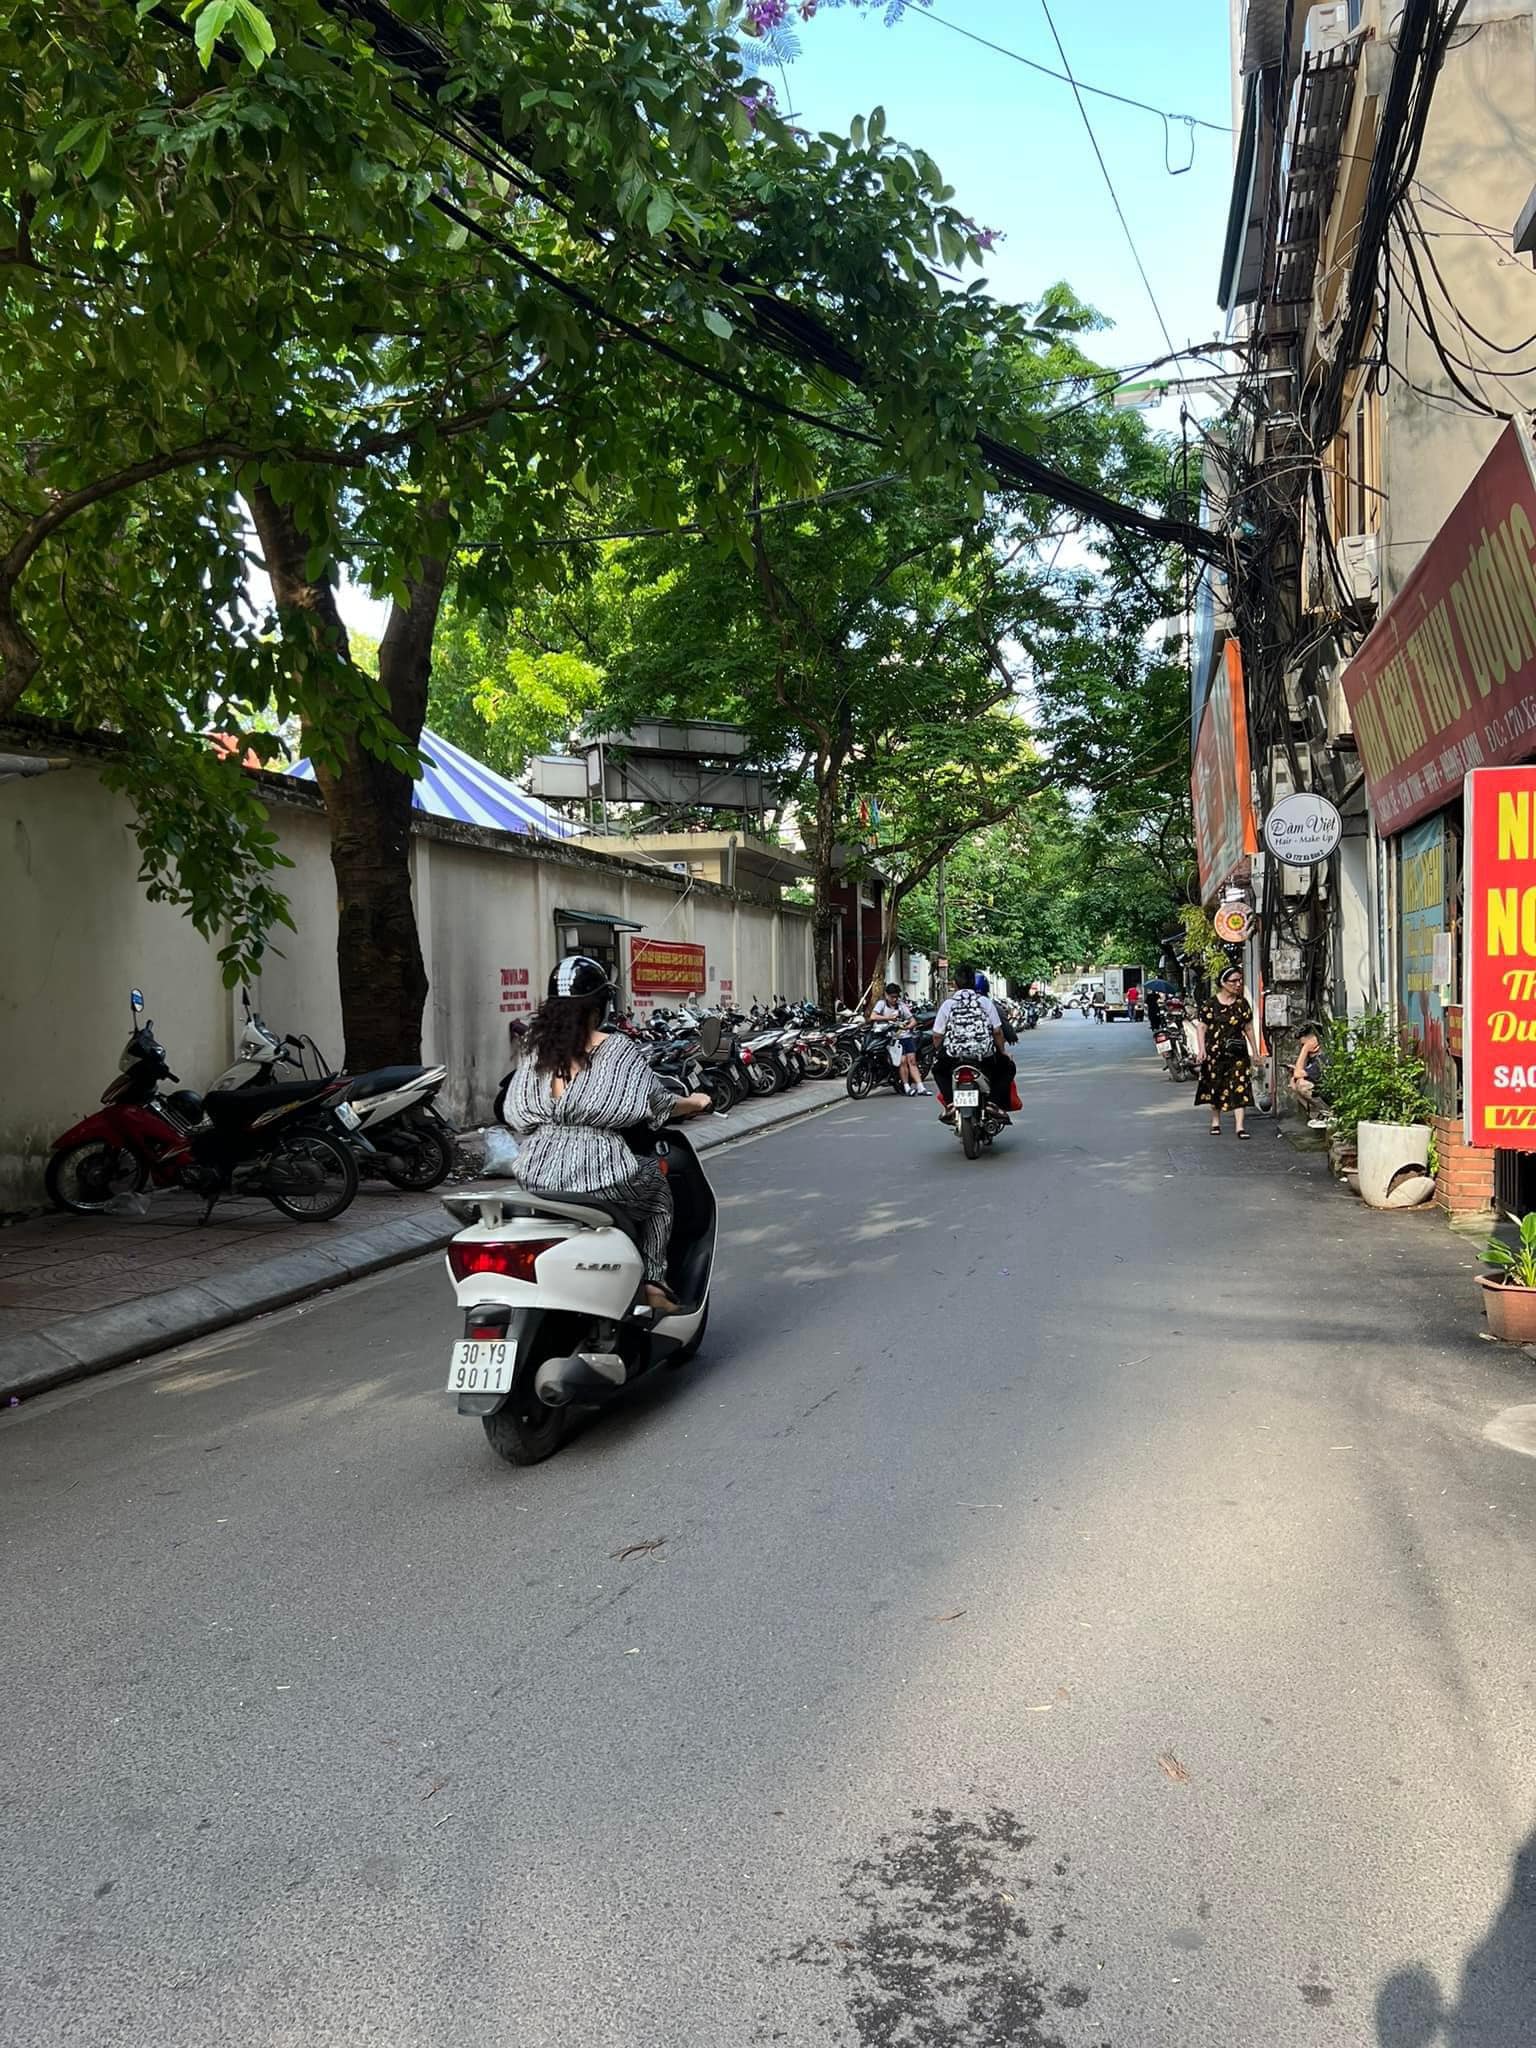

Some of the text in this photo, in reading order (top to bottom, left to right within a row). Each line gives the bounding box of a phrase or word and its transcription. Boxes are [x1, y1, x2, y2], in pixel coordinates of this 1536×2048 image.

[1504, 705, 1525, 741] 170
[1275, 836, 1292, 846] Hair
[1300, 834, 1320, 844] Make
[455, 1367, 503, 1389] 9011
